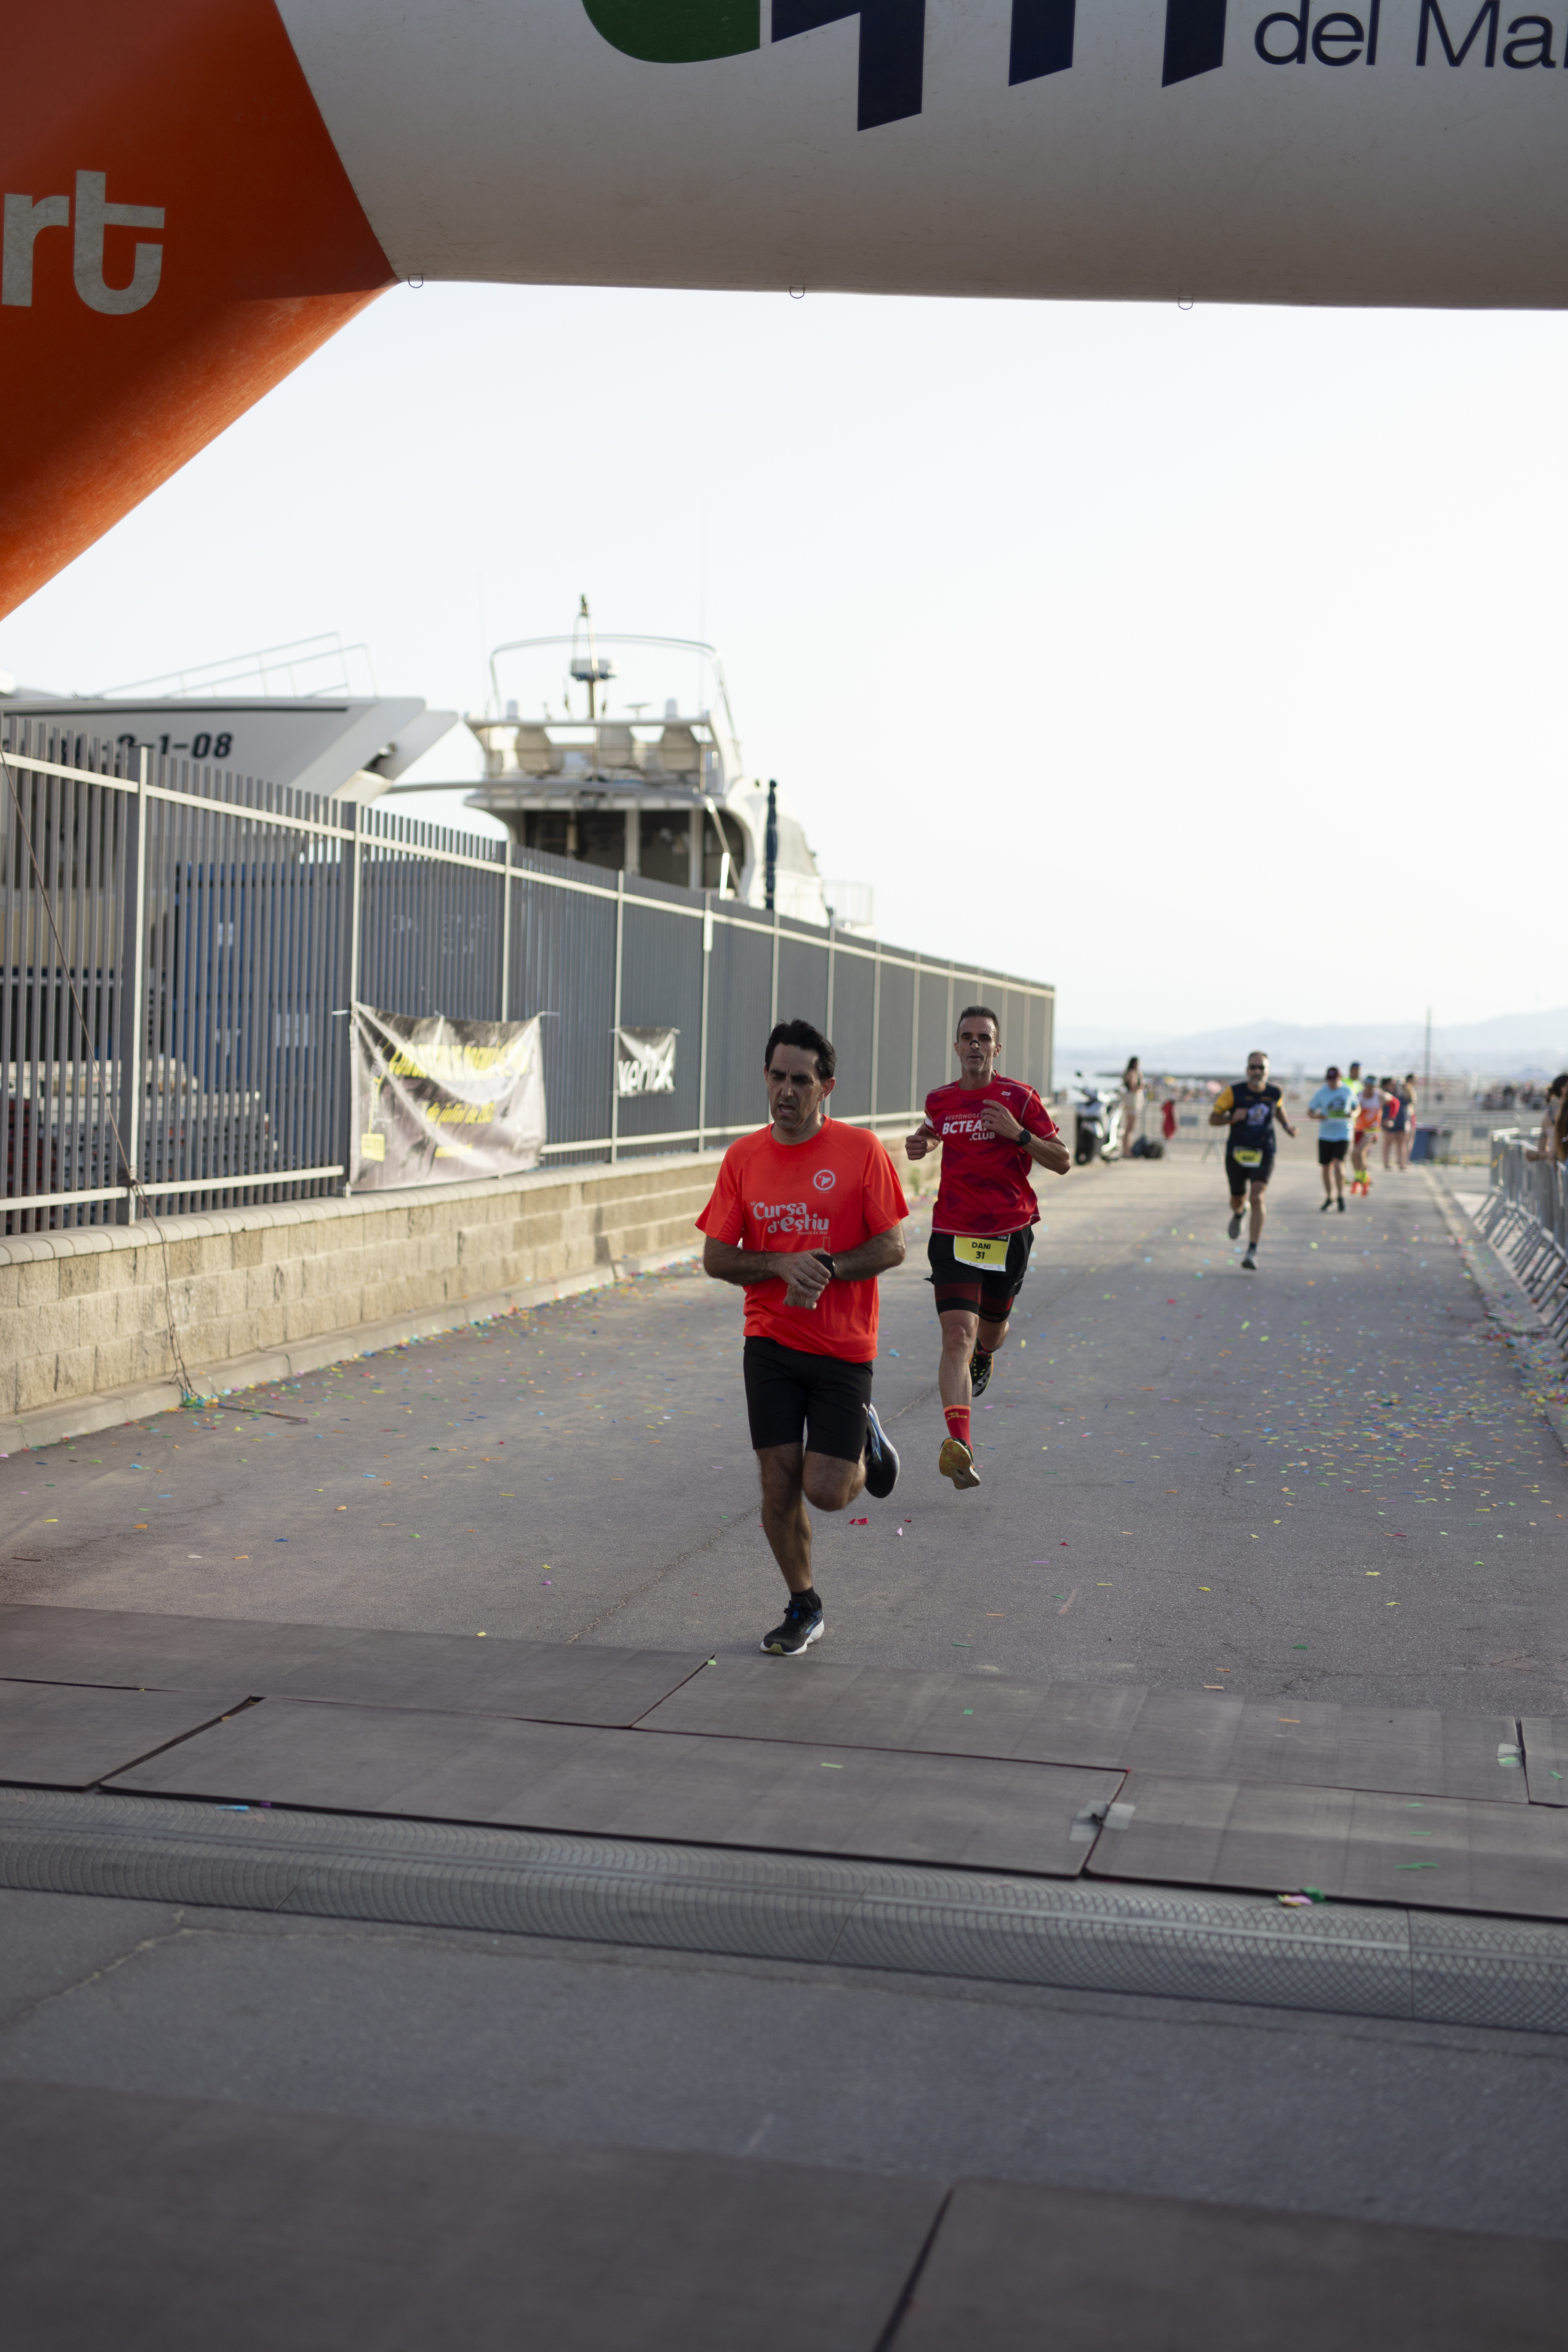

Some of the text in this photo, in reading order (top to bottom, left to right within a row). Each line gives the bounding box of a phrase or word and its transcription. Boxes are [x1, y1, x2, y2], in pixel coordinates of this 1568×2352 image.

[1254, 0, 1380, 67] del
[1416, 0, 1568, 69] Ma
[942, 1120, 987, 1135] BCTEA
[753, 1202, 807, 1220] Cursa
[972, 1241, 991, 1250] DANI
[975, 1251, 985, 1260] 31
